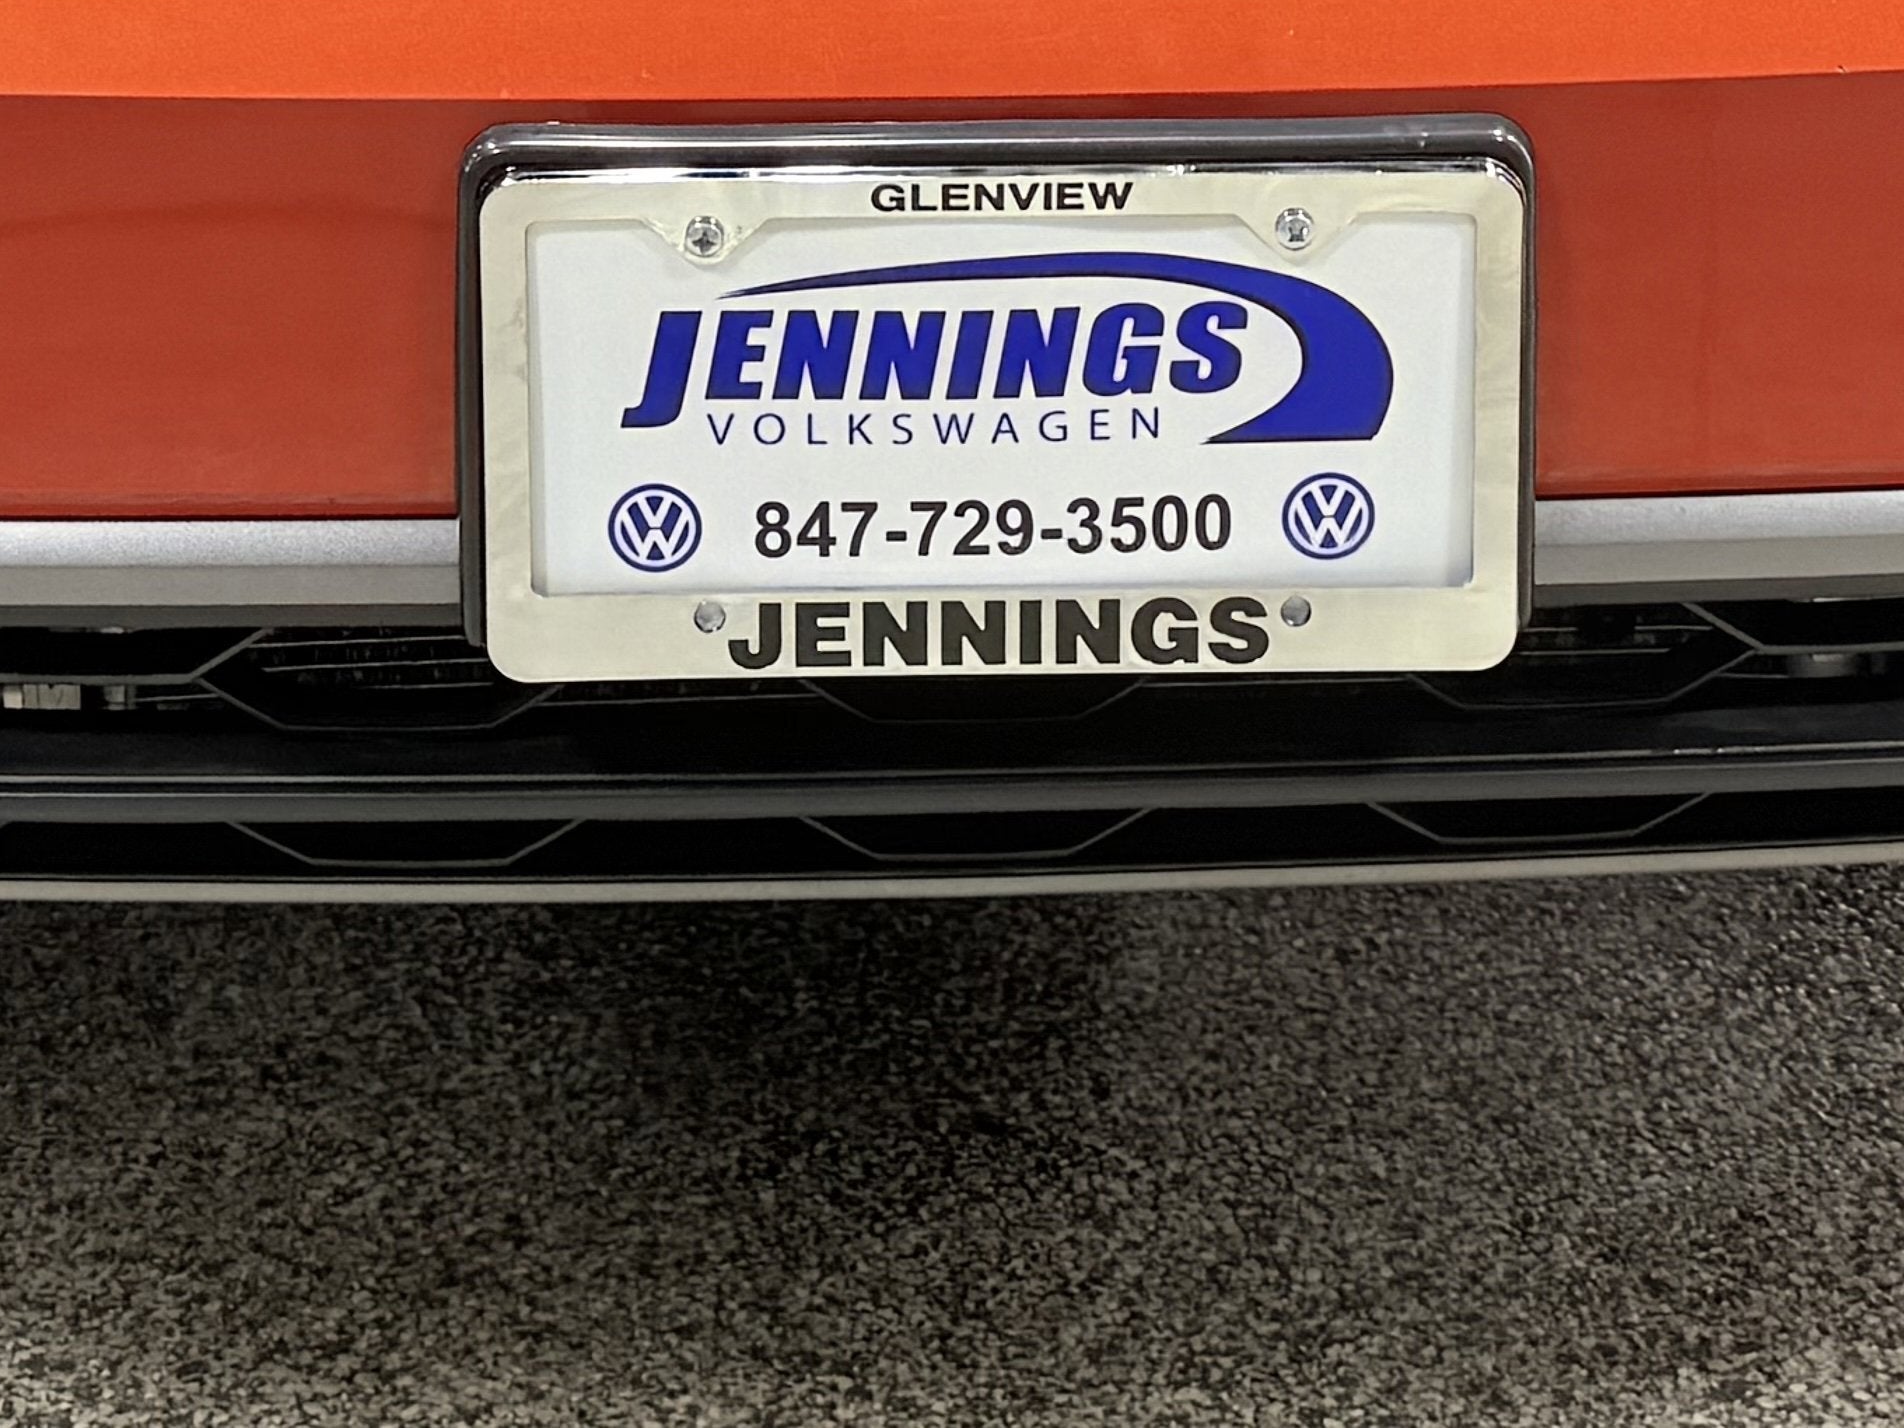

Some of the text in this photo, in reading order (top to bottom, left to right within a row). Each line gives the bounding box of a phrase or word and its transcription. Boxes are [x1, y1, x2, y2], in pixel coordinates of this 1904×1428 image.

[869, 180, 1134, 212] GLENVIEW
[619, 300, 1250, 430] JENNINGS
[706, 407, 1162, 446] VOLKSWAGEN
[753, 492, 1233, 558] 847-729-3500
[727, 596, 1272, 669] JENNINGS
